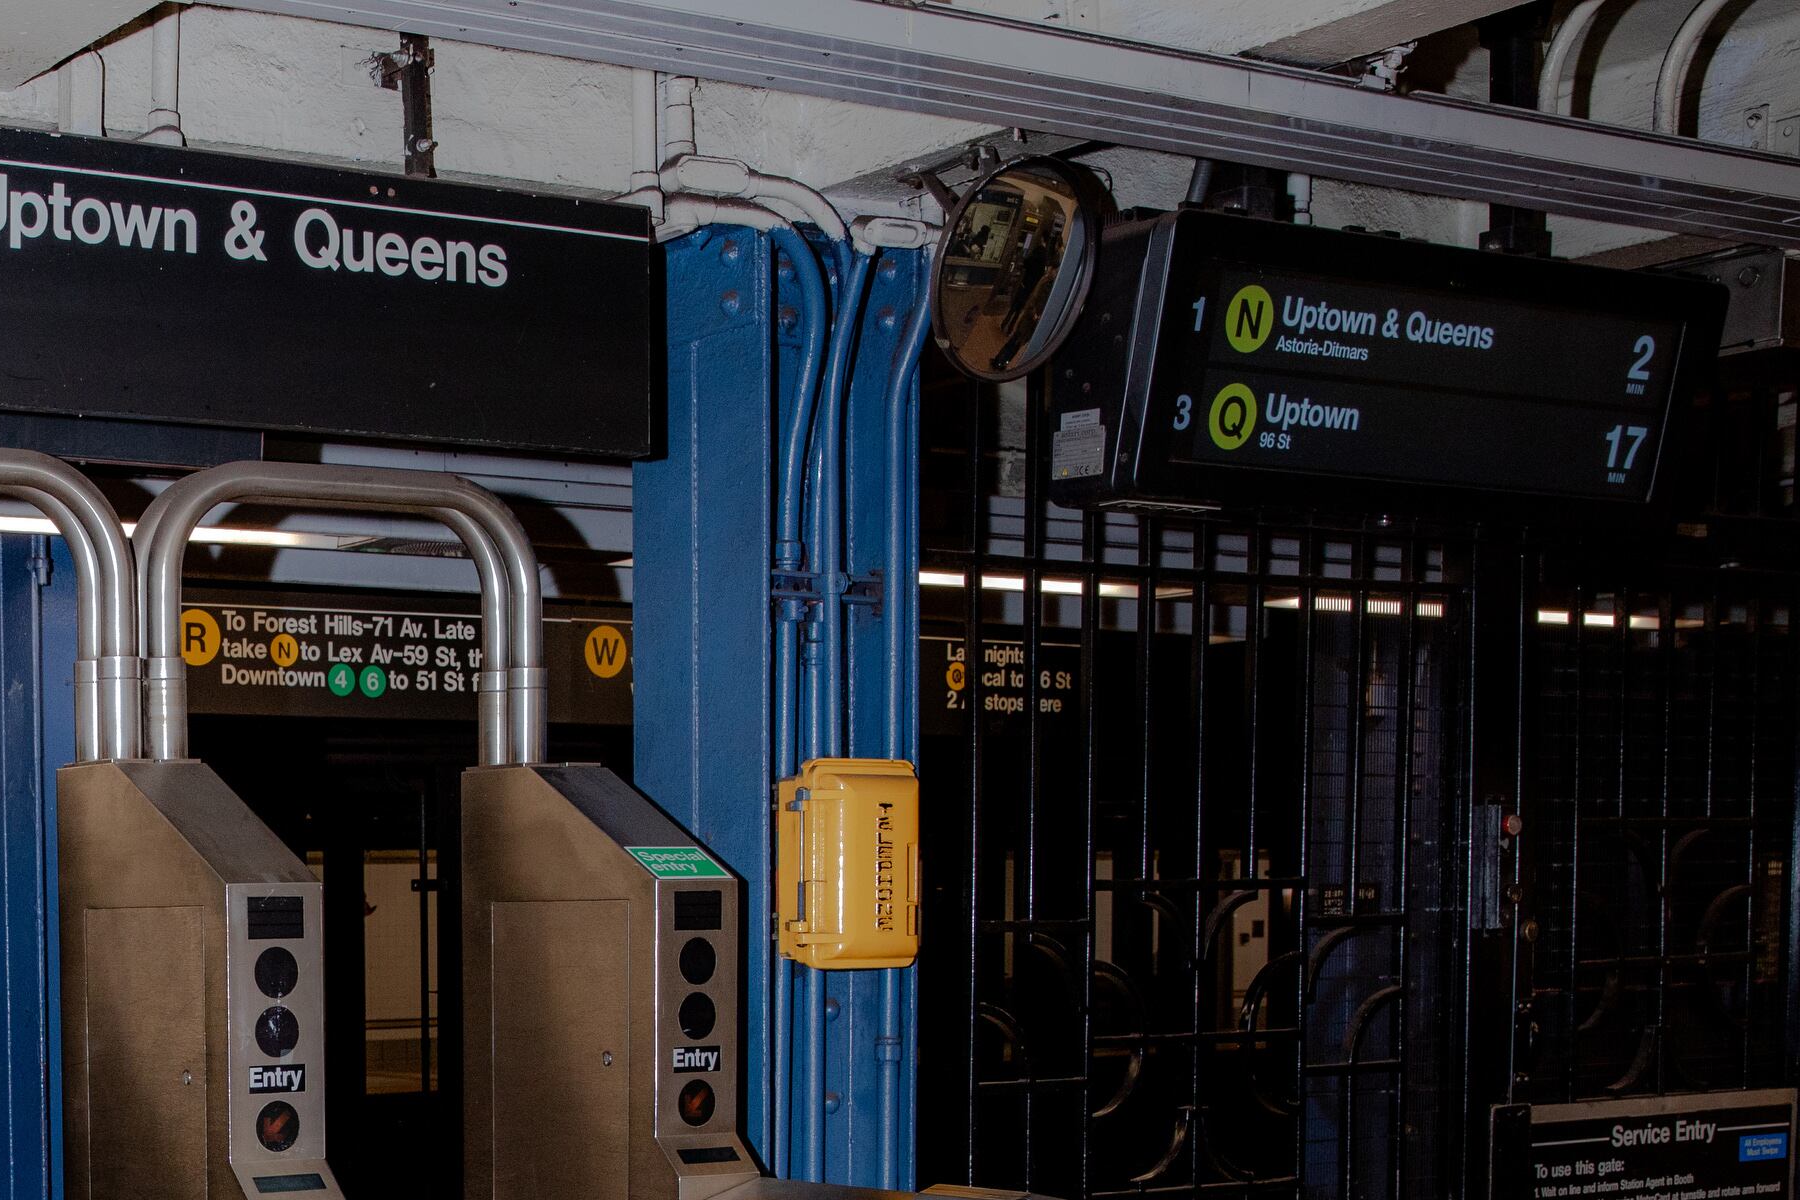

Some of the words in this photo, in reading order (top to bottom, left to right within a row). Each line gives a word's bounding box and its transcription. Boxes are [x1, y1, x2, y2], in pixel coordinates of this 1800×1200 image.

[224, 200, 268, 262] &
[294, 208, 509, 288] Queens
[1192, 297, 1206, 332] 1
[1235, 298, 1265, 340] N
[1281, 296, 1376, 338] Uptown
[1381, 308, 1399, 339] &
[1405, 311, 1494, 350] Queens
[1627, 335, 1656, 380] 2
[1275, 335, 1369, 361] Astoria-Ditmars
[1626, 383, 1644, 395] MIN
[1173, 395, 1191, 430] 3
[1218, 396, 1246, 440] Q
[1265, 392, 1359, 435] Uptown
[1605, 426, 1648, 470] 17
[1259, 432, 1275, 449] 96
[1276, 433, 1292, 450] St
[1607, 472, 1626, 484] MIN
[185, 622, 207, 653] R
[222, 610, 246, 632] To
[254, 611, 317, 634] Forest
[324, 614, 394, 637] Hills-71
[400, 617, 428, 639] Av.
[434, 619, 476, 641] Late
[222, 638, 268, 659] take
[278, 642, 291, 659] N
[300, 641, 321, 661] to
[327, 641, 363, 664] Lex
[370, 643, 429, 666] Av-59
[435, 646, 461, 670] St,
[592, 637, 620, 667] W
[221, 663, 326, 687] Downtown
[334, 670, 348, 689] 4
[366, 673, 379, 691] 6
[388, 670, 409, 691] to
[416, 670, 438, 691] 51
[443, 671, 465, 692] St
[1055, 671, 1072, 690] St
[984, 693, 1024, 715] stops
[1039, 698, 1062, 713] ere
[637, 850, 705, 862] Special
[651, 861, 698, 873] entry
[673, 1047, 719, 1071] Entry
[249, 1066, 303, 1091] Entry
[1611, 1122, 1670, 1147] Service
[1675, 1120, 1717, 1143] Entry
[1534, 1163, 1549, 1179] To
[1551, 1165, 1572, 1178] use
[1575, 1160, 1595, 1175] this
[1597, 1157, 1625, 1177] gate:
[1541, 1186, 1557, 1198] Wait
[1558, 1187, 1568, 1196] on
[1569, 1184, 1581, 1195] line
[1582, 1182, 1596, 1194] and
[1597, 1181, 1619, 1193] inform
[1620, 1178, 1644, 1191] Station
[1645, 1176, 1666, 1190] Agent
[1666, 1175, 1673, 1185] in
[1673, 1173, 1694, 1185] Booth
[1707, 1187, 1721, 1199] and
[1721, 1185, 1740, 1197] rotate
[1741, 1186, 1755, 1195] arm
[1756, 1181, 1781, 1193] forward
